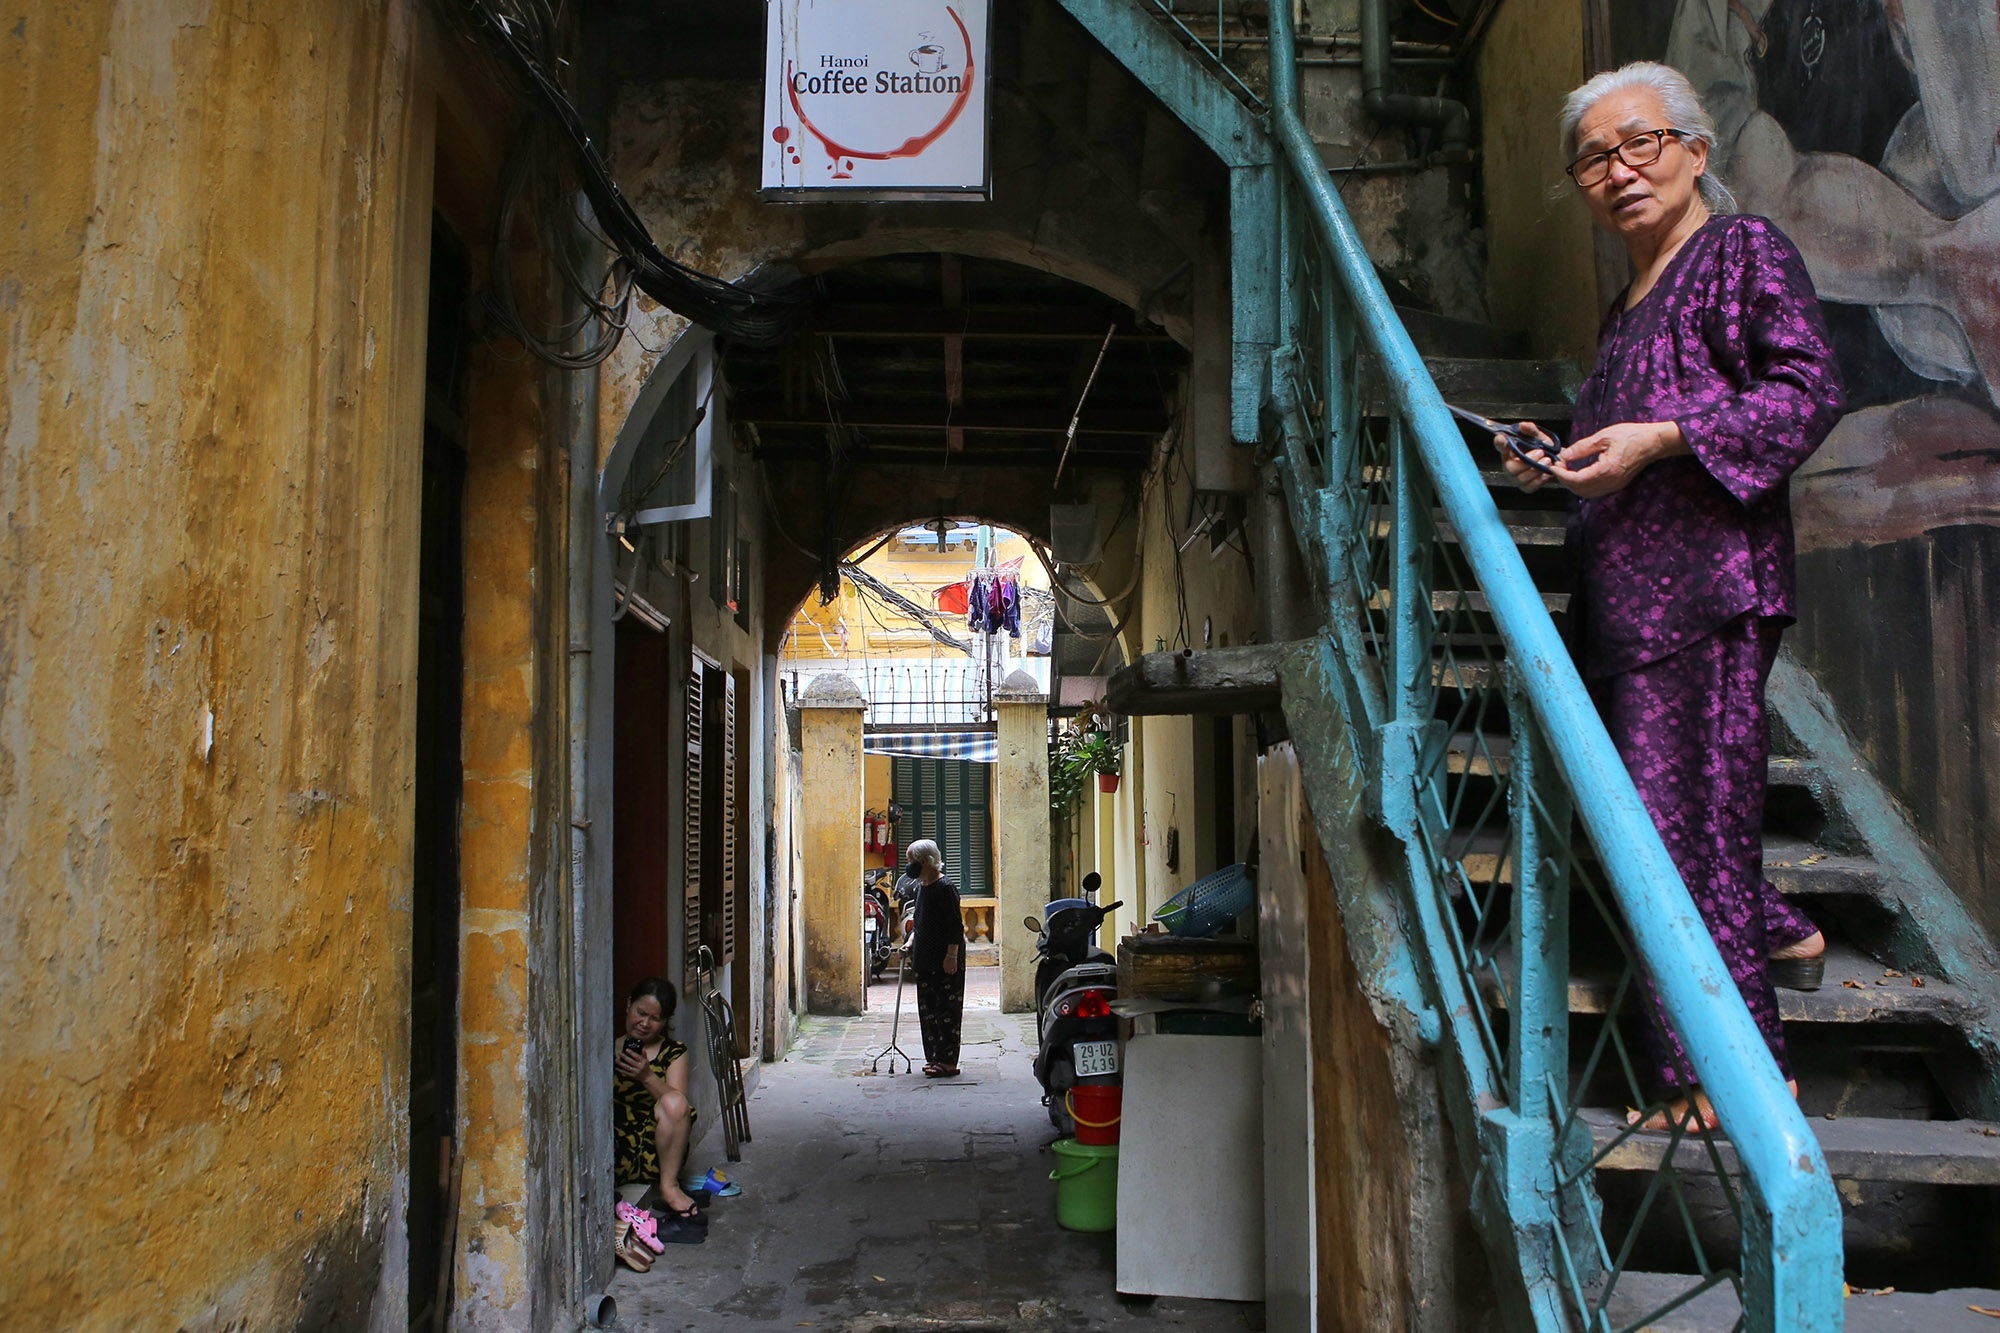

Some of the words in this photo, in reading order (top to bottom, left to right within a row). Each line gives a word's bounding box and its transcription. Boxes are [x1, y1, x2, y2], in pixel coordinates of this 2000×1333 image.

[820, 54, 869, 68] Hanoi
[793, 70, 868, 94] Coffee
[875, 71, 963, 94] Station
[1081, 1043, 1114, 1058] 29-U2
[1082, 1057, 1116, 1073] 5439
